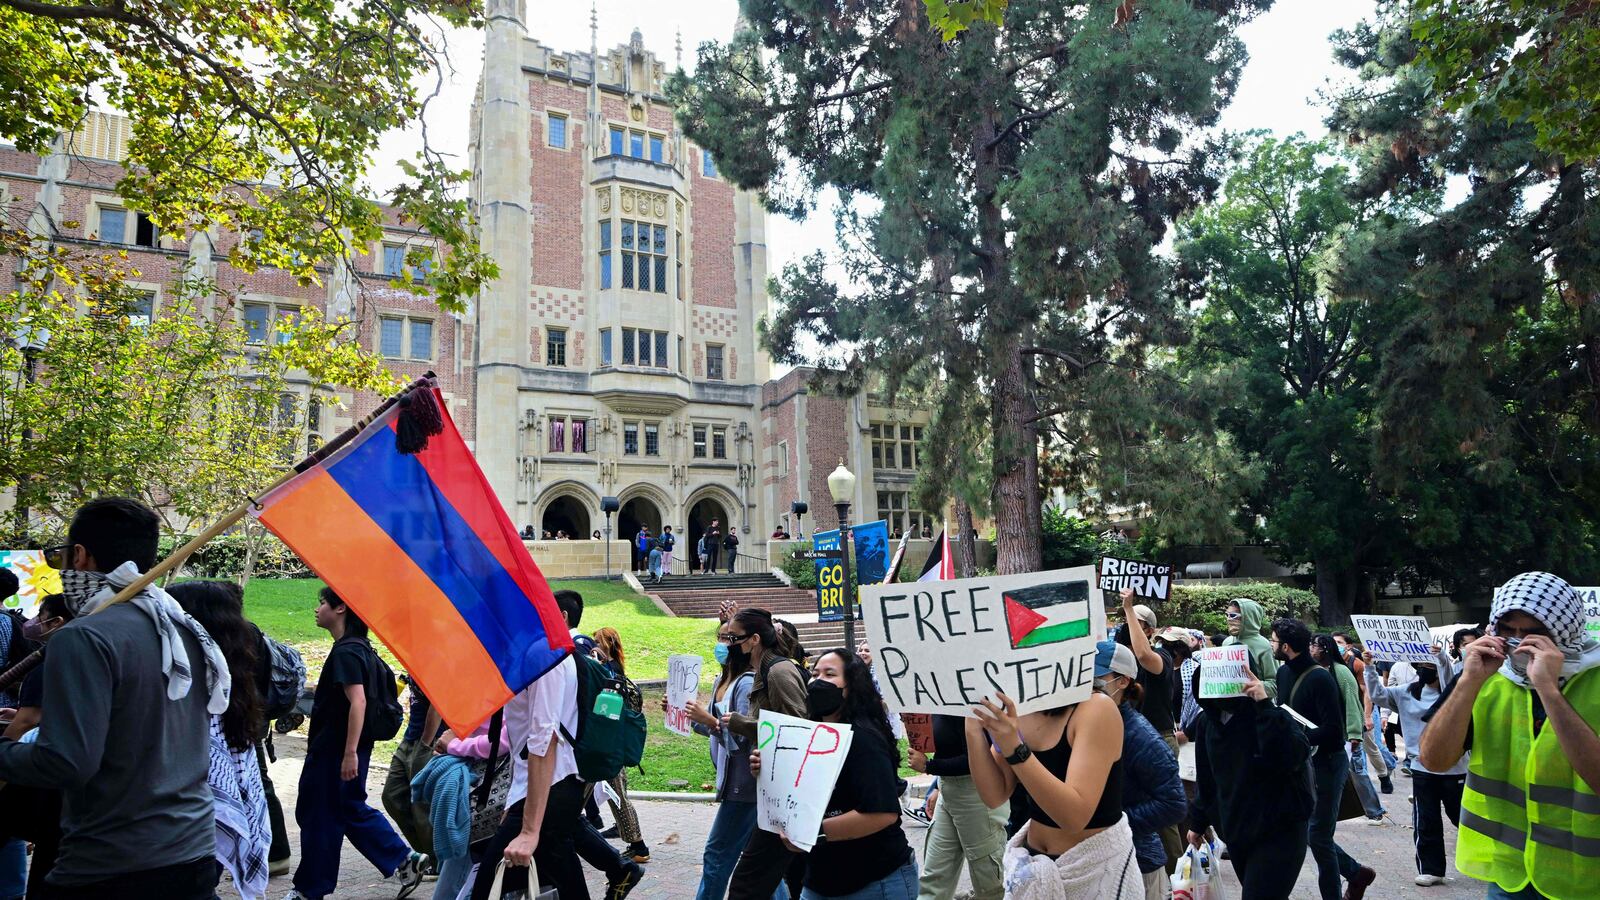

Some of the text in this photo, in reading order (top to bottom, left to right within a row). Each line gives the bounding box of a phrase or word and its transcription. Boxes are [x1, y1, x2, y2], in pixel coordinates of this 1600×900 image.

[1101, 557, 1170, 576] RIGHT OF
[820, 564, 843, 587] GO
[1099, 575, 1169, 600] RETURN
[880, 586, 993, 644] FREE
[1356, 618, 1430, 632] FROM THE RIVER
[1375, 630, 1387, 640] TO
[1387, 630, 1402, 642] THE
[1202, 649, 1246, 661] LONG LIVE
[1365, 639, 1432, 655] PALESTINE
[880, 646, 1097, 710] PALESTINE
[1203, 682, 1245, 696] SOLIDARIT
